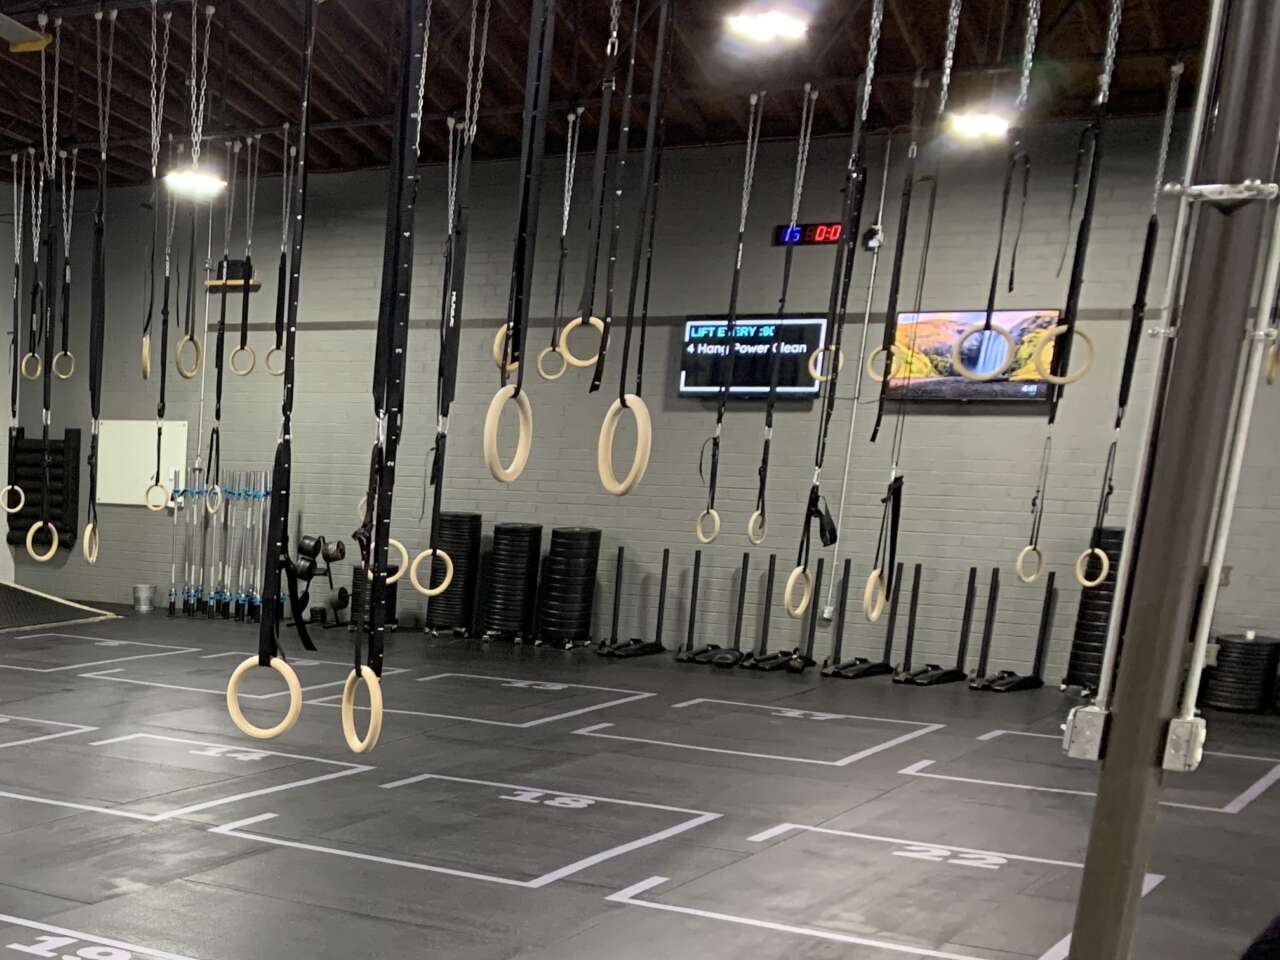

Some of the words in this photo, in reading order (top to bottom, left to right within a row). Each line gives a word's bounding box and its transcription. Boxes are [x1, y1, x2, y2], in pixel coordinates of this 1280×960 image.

[691, 326, 715, 338] LIFT
[686, 343, 694, 354] 4
[188, 747, 272, 761] 14
[498, 791, 596, 808] 18
[891, 845, 1009, 870] 22
